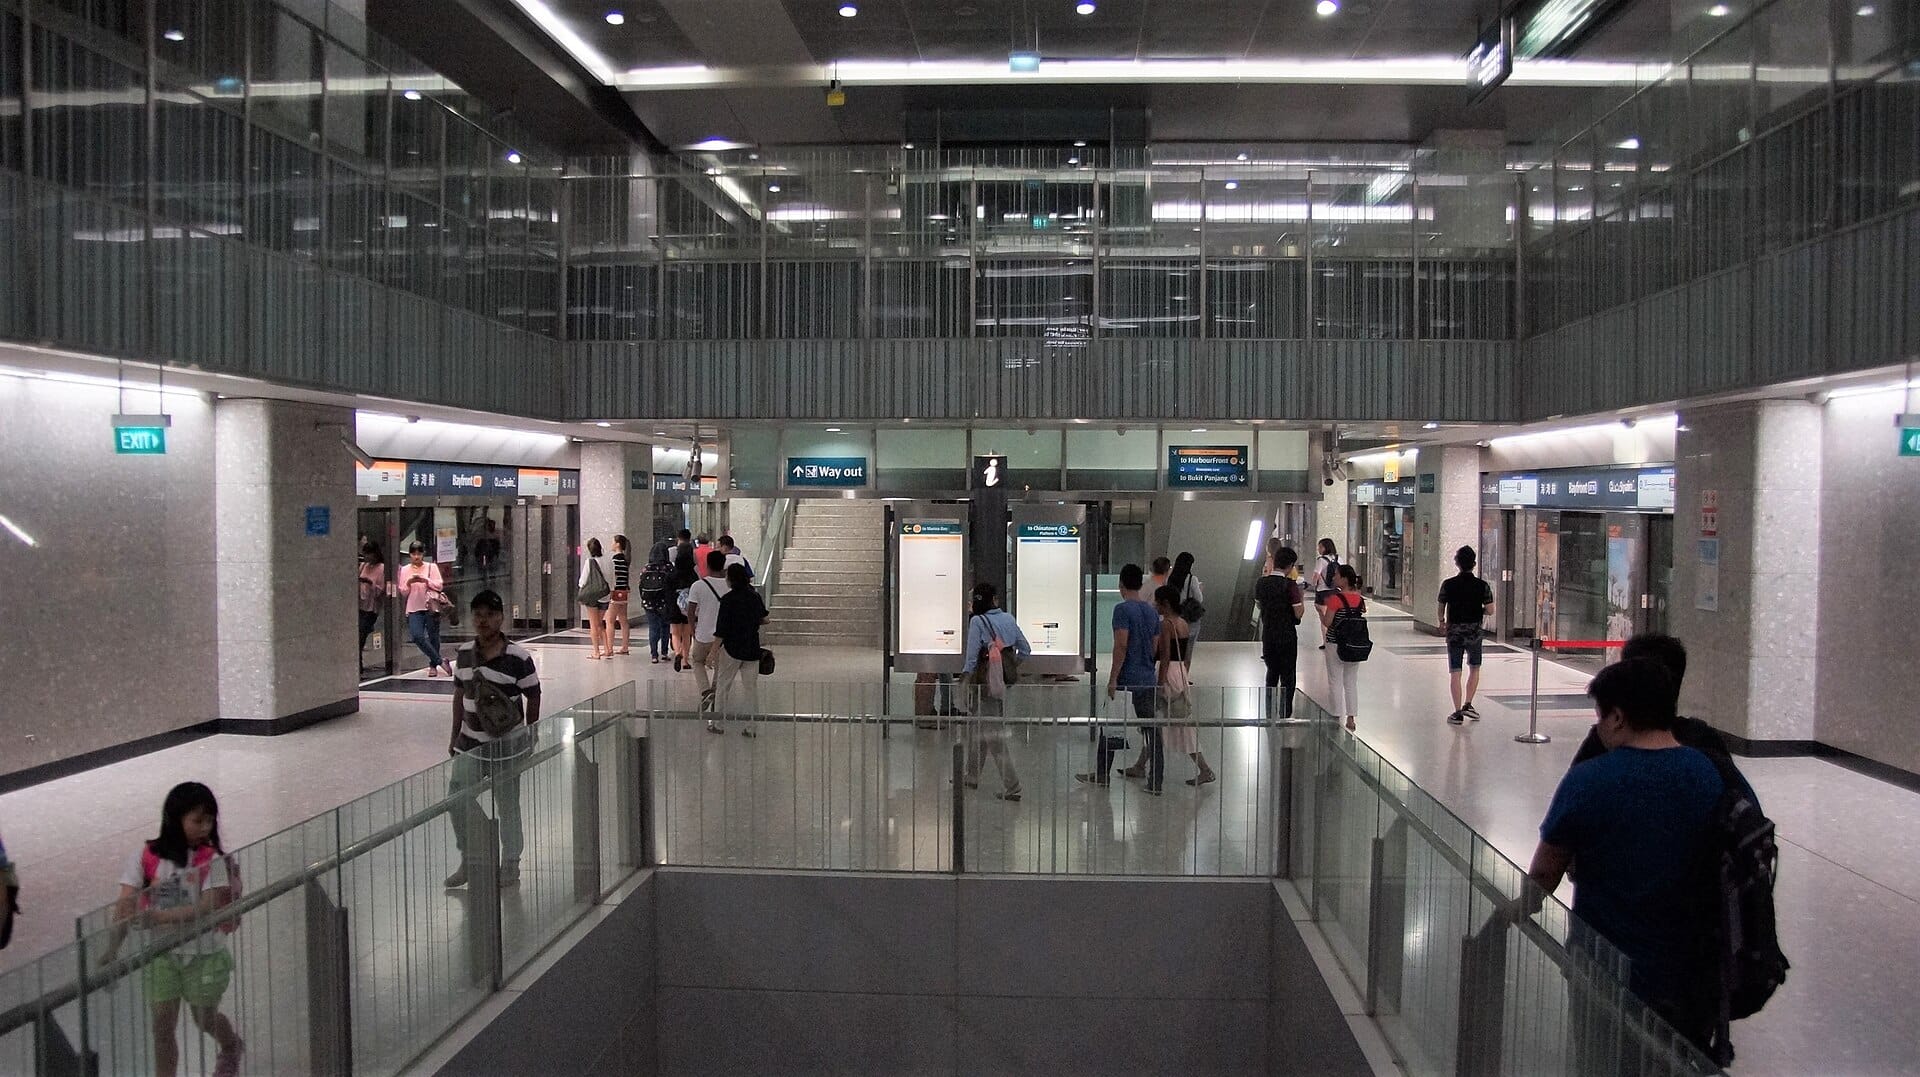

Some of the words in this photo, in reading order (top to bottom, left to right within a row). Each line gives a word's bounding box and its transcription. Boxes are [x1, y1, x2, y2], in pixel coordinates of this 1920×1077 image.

[120, 431, 150, 449] EXIT
[819, 466, 841, 479] Way
[843, 466, 863, 477] out
[1204, 474, 1228, 482] Panjang
[452, 473, 473, 488] Bayfront
[1568, 480, 1588, 496] Bayfront
